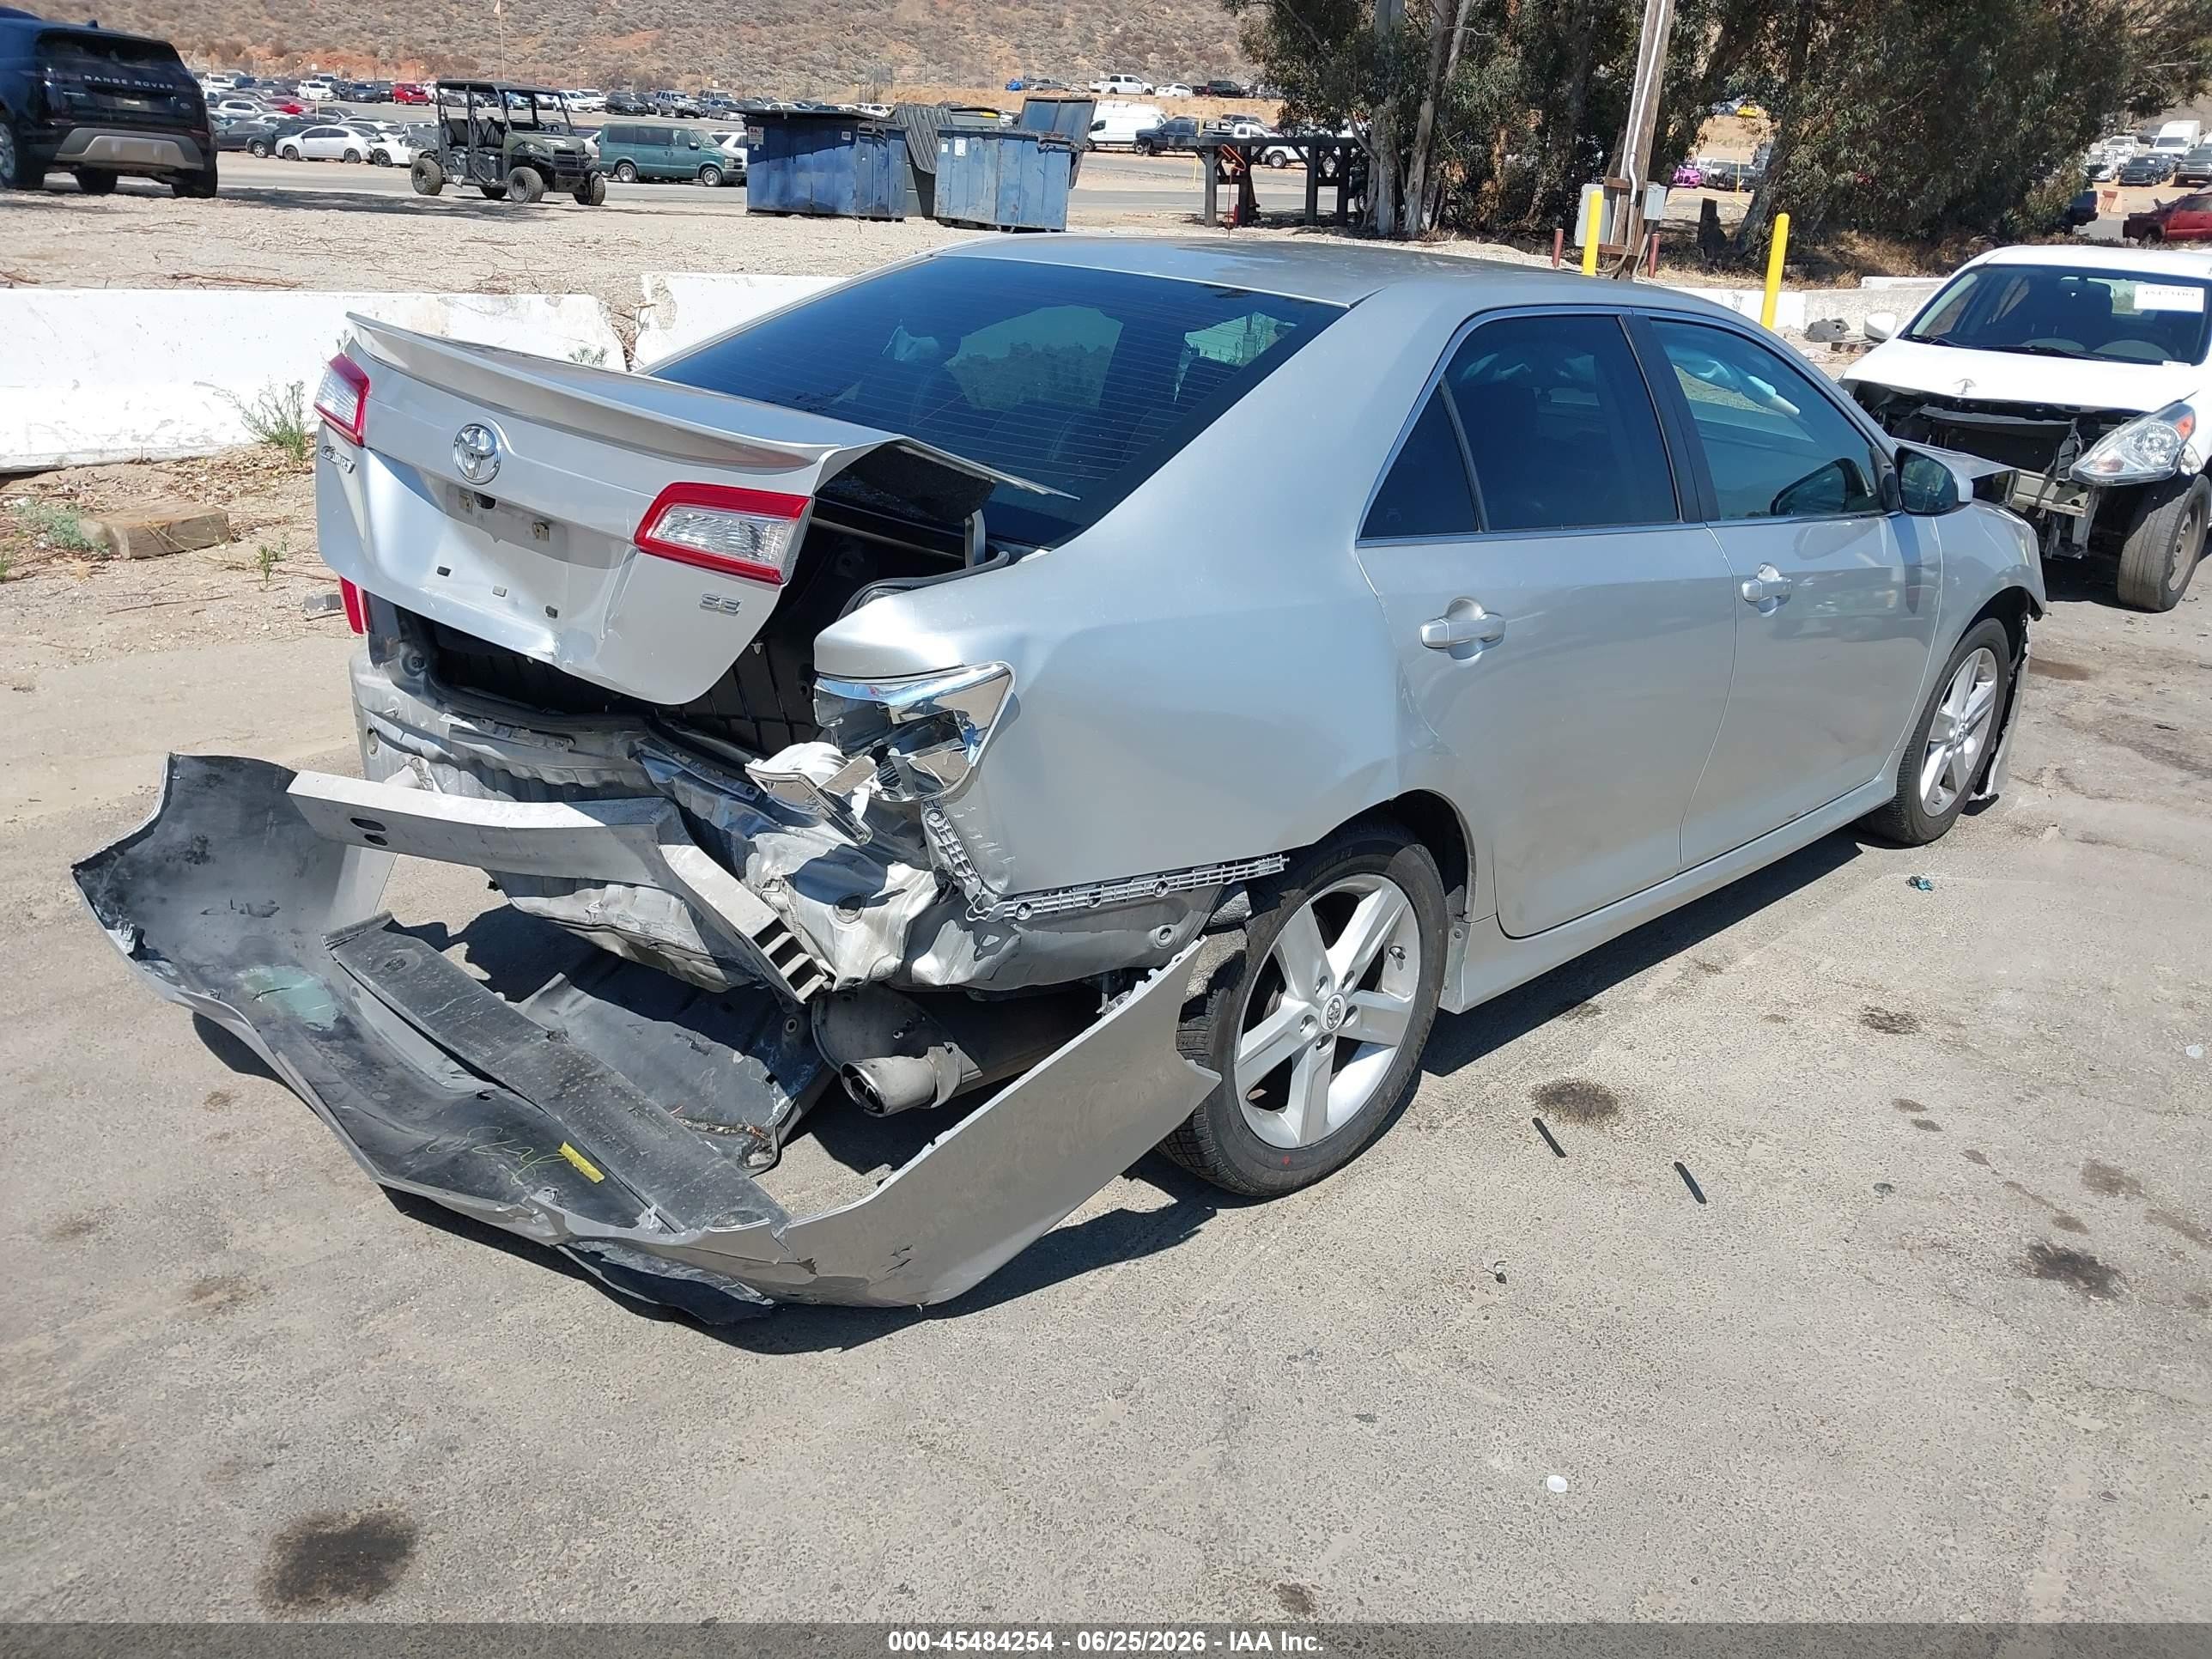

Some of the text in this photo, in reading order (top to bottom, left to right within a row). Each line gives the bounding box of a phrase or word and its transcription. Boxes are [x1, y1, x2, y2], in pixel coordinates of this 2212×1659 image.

[84, 75, 173, 89] RANGE ROVER
[320, 445, 356, 474] CAMRY
[699, 592, 742, 617] SE
